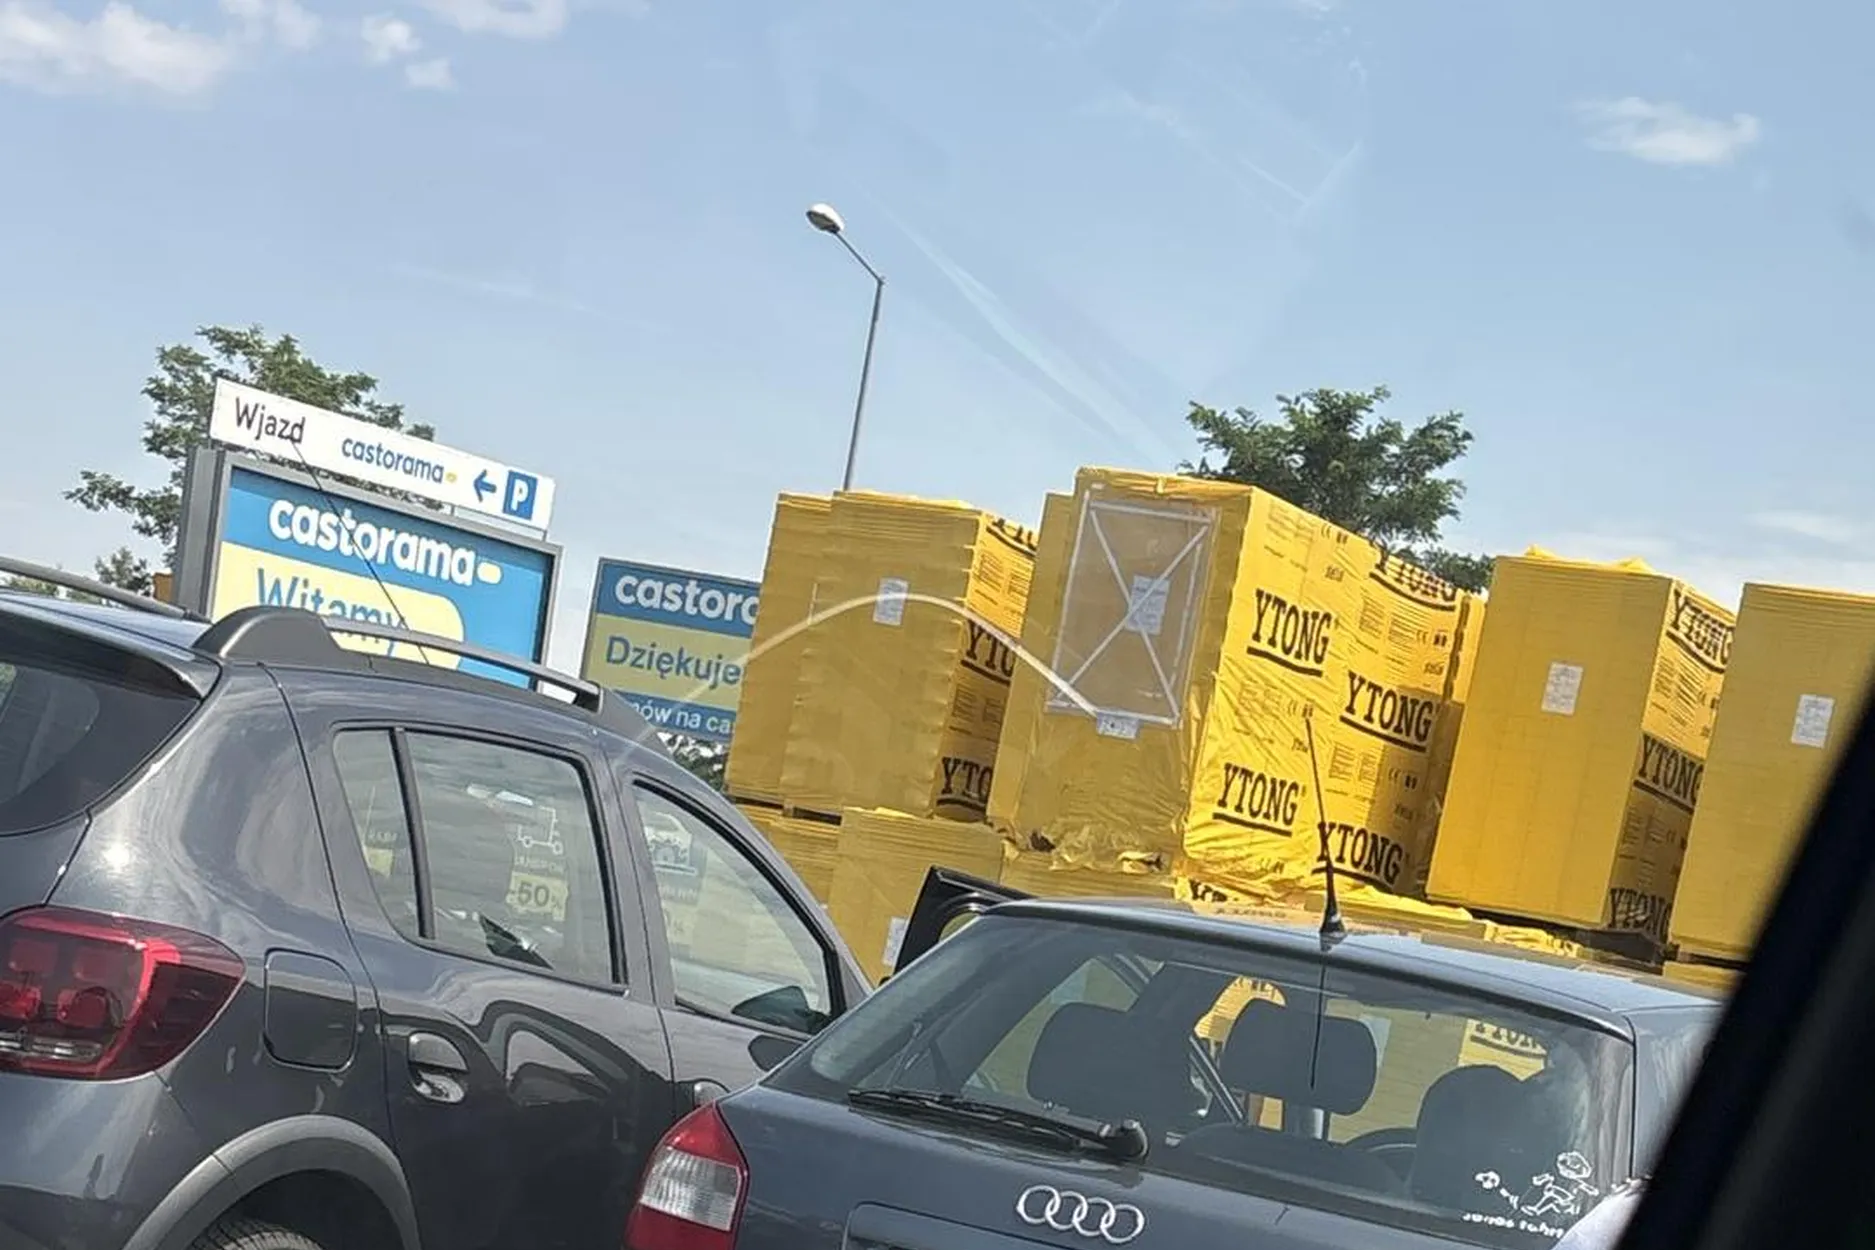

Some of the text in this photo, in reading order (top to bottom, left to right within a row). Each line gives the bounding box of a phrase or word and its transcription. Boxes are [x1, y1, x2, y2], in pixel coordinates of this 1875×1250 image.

[235, 397, 530, 512] Wjazd castorama P
[268, 498, 477, 587] castorama
[1252, 588, 1333, 665] YTONG
[606, 635, 742, 690] Dziękuje
[676, 710, 701, 729] na
[1344, 669, 1433, 743] YTONG
[1217, 762, 1299, 826] YTONG
[1316, 820, 1404, 885] YTONG
